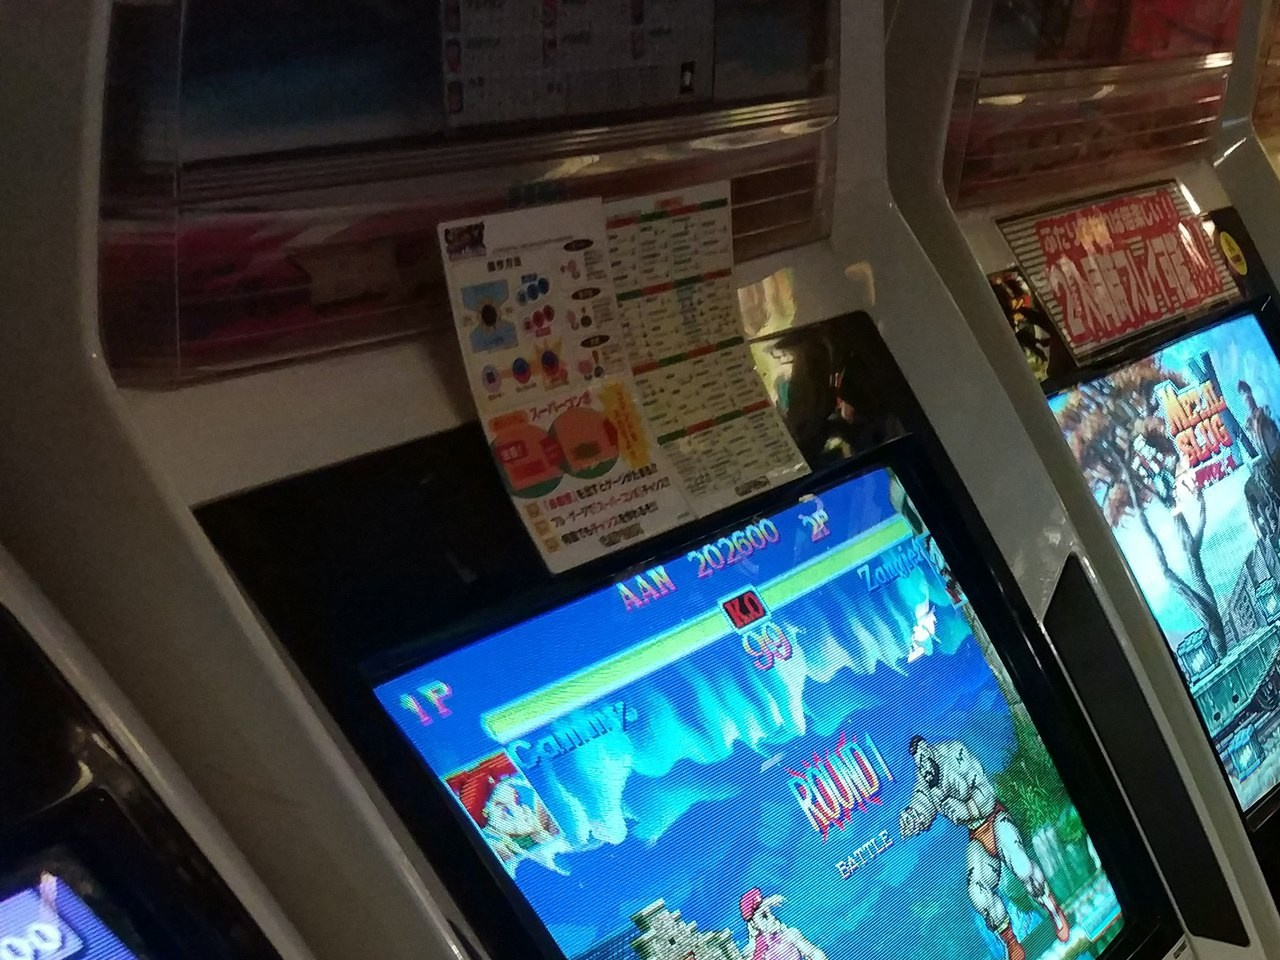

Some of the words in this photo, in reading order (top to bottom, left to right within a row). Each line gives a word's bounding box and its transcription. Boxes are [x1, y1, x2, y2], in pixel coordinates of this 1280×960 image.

[687, 518, 780, 578] 202600
[400, 680, 452, 725] 1P
[835, 829, 893, 879] BATTLE
